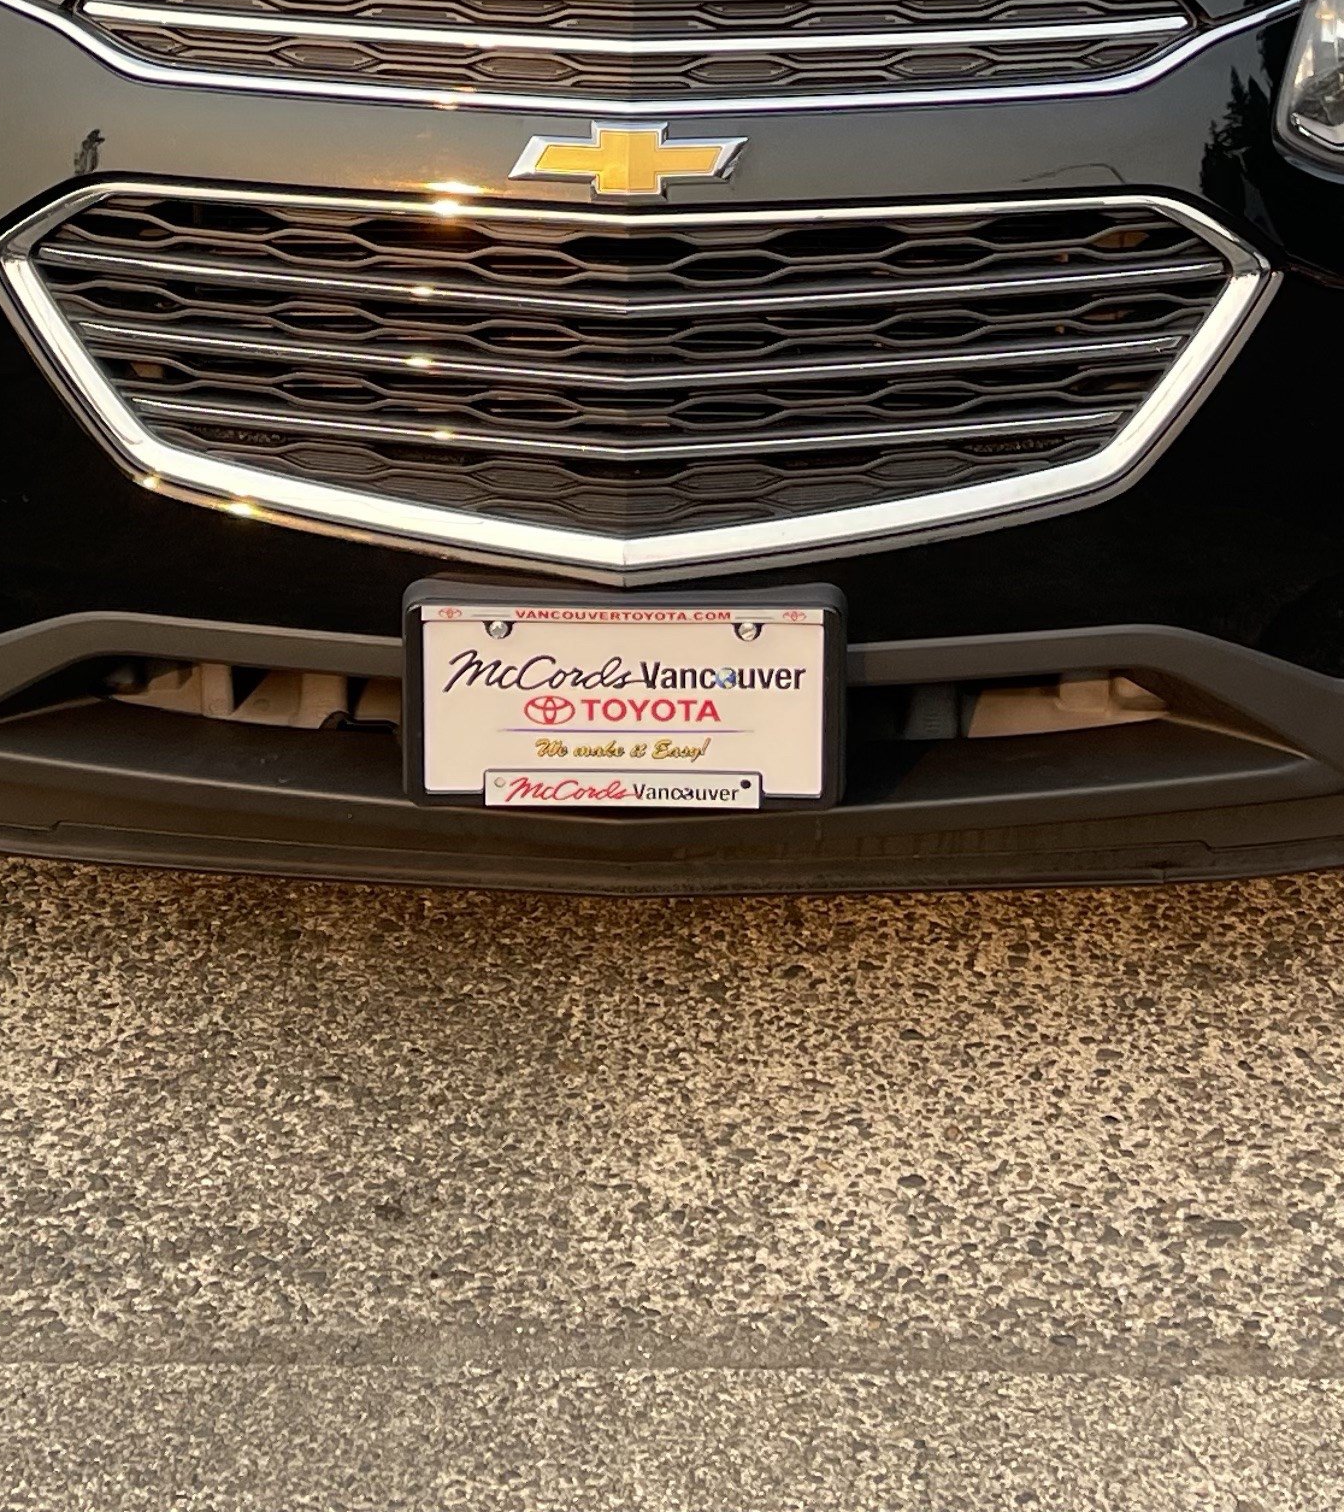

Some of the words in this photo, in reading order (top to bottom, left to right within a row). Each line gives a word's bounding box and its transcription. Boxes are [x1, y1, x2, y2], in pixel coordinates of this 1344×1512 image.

[515, 609, 731, 622] VANCOUVERTOYOTA.COM
[580, 698, 722, 722] TOYOTA
[535, 738, 568, 758] We
[573, 740, 625, 758] make
[630, 742, 647, 758] it
[651, 737, 712, 763] Easy!
